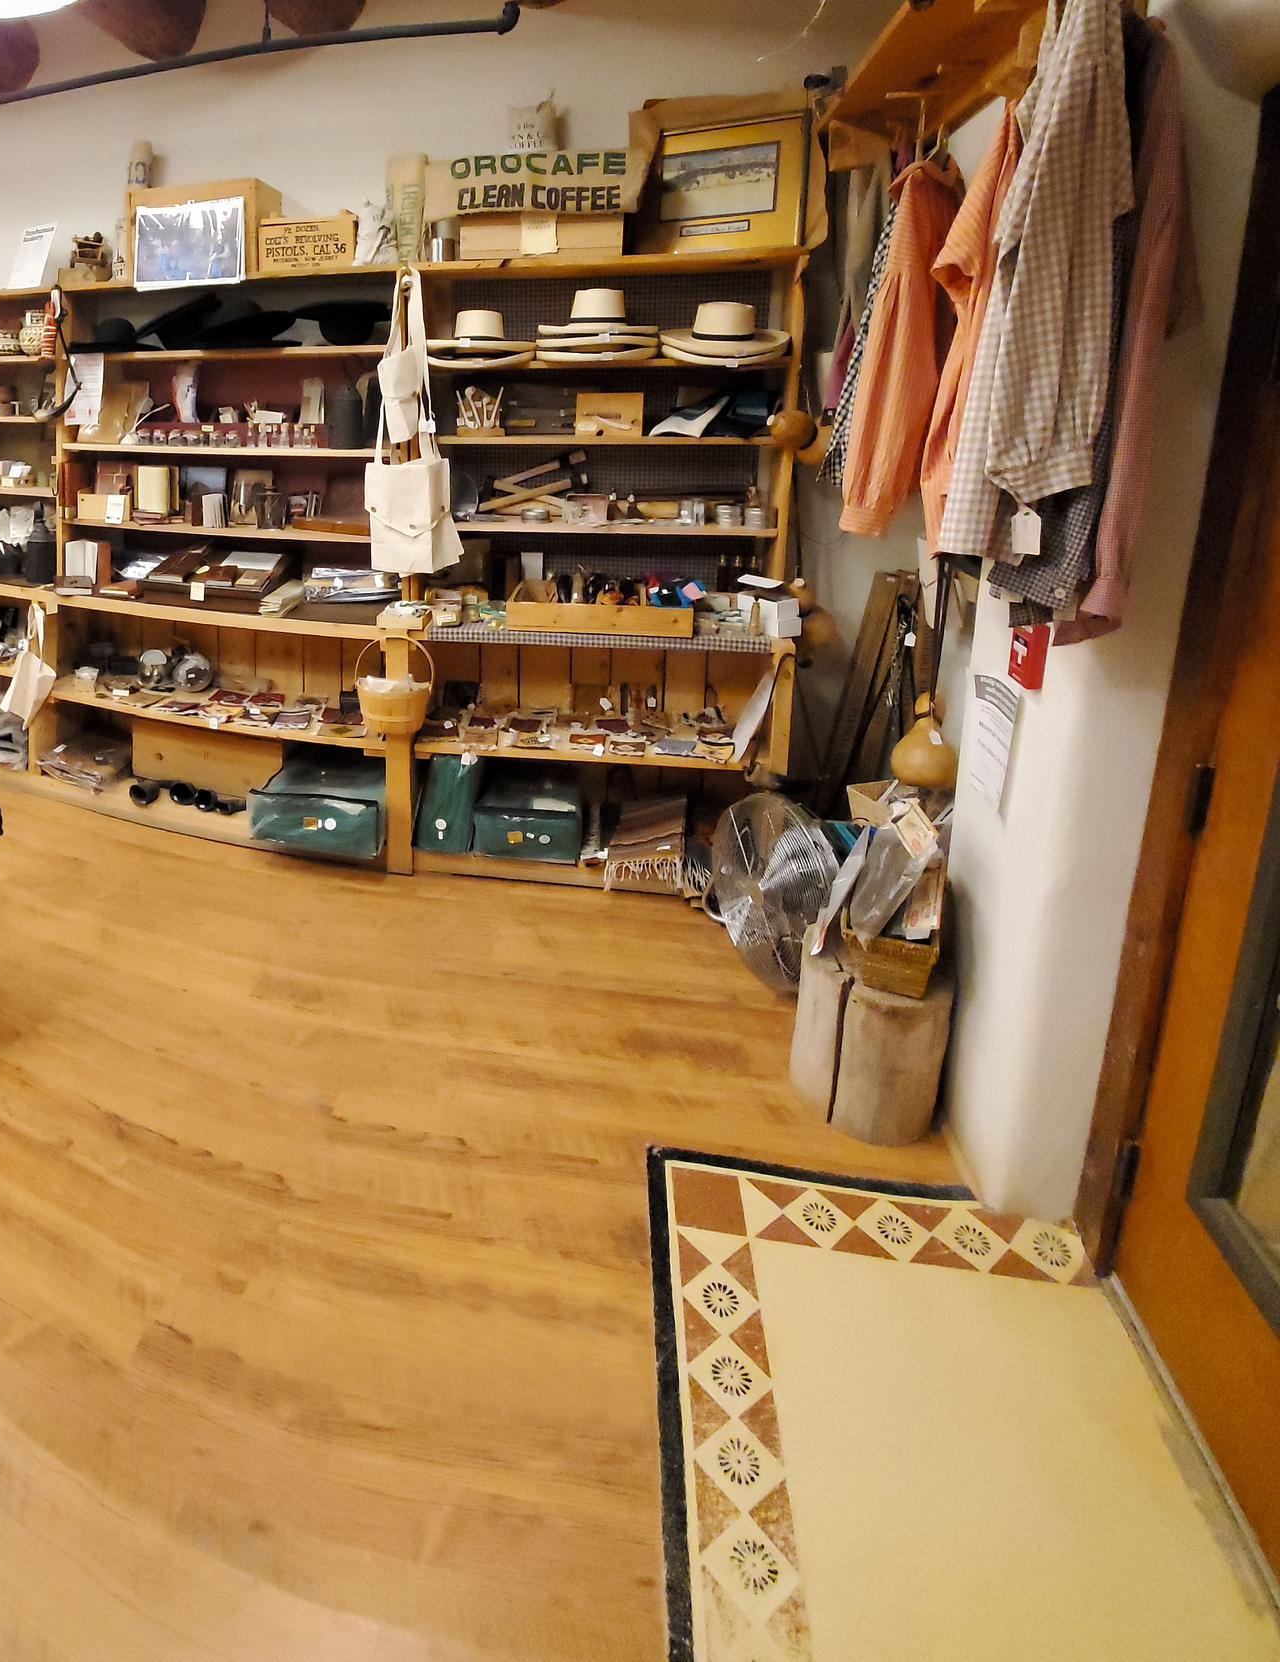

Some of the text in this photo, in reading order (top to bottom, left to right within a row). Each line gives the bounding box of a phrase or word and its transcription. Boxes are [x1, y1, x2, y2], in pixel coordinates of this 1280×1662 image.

[450, 152, 627, 180] OROCAFE
[457, 182, 621, 212] CLEAN COFFEE
[294, 233, 339, 244] REVOLVING
[333, 243, 347, 254] 36
